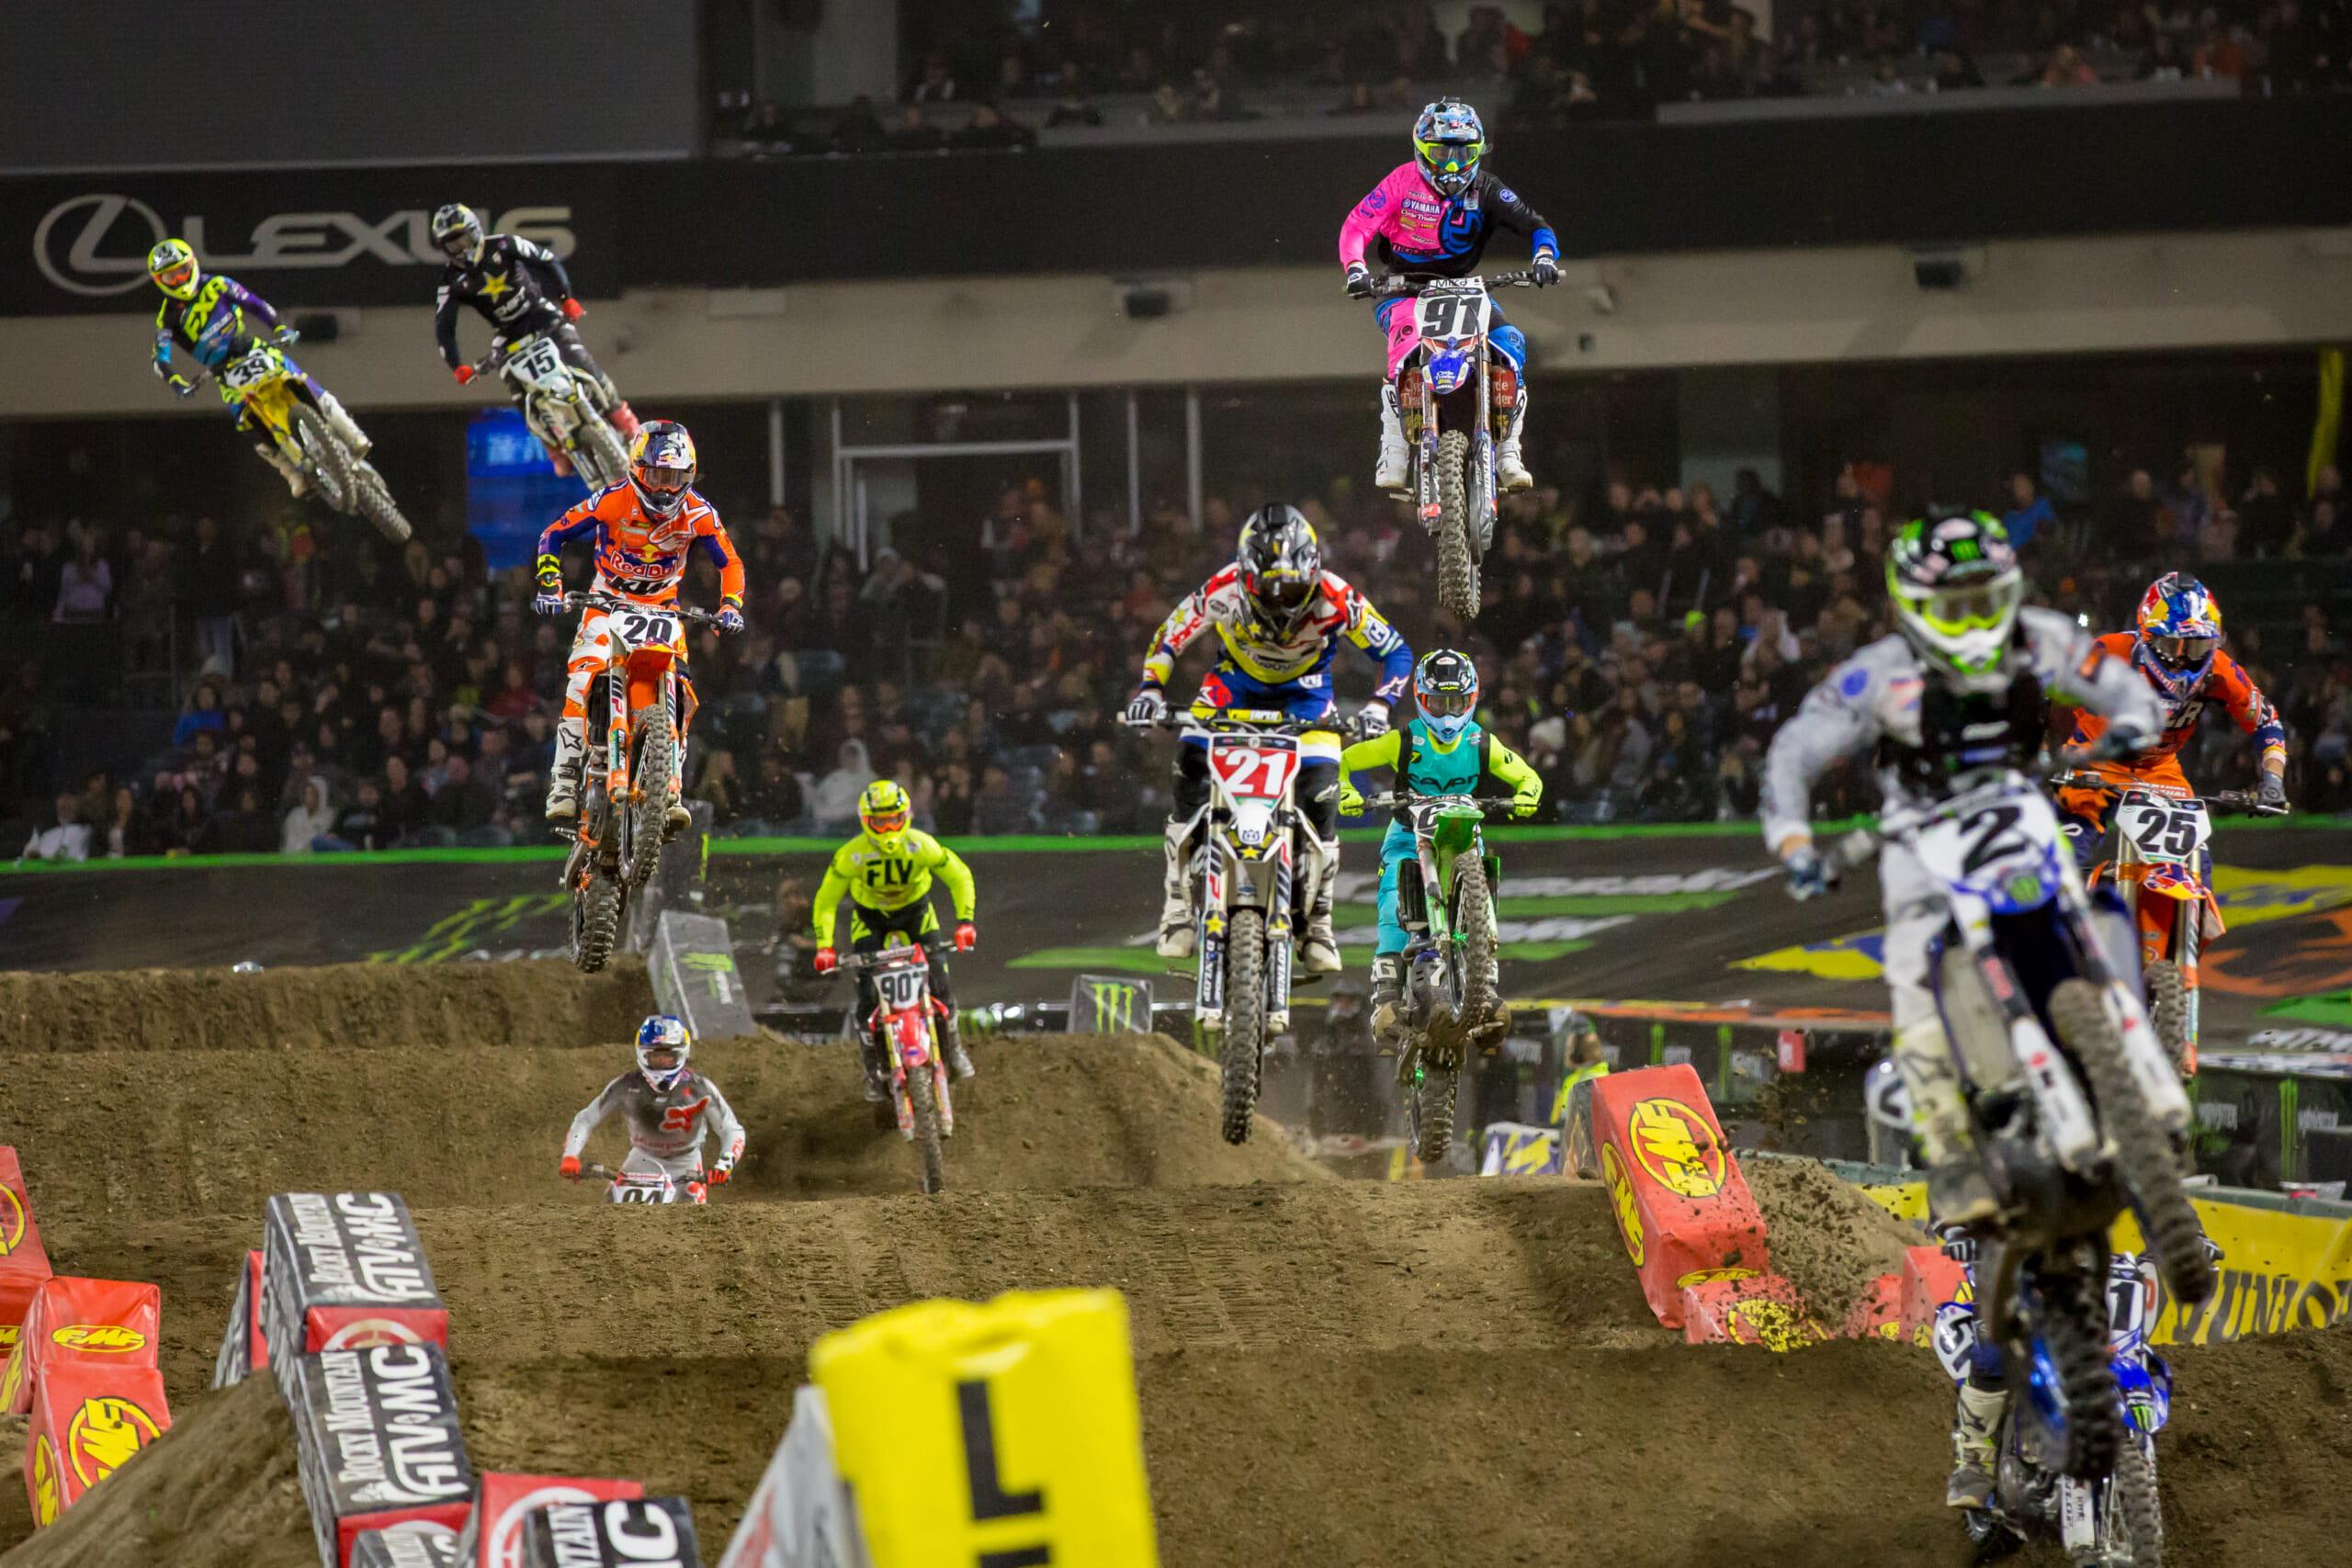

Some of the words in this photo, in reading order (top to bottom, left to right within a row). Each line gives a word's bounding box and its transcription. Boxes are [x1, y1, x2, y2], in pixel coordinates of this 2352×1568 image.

[1410, 200, 1441, 215] YAMAHA
[186, 206, 576, 267] LEXUS
[184, 276, 228, 343] FXR
[1421, 297, 1482, 337] 91
[521, 349, 557, 380] 15
[610, 551, 648, 576] Red
[623, 615, 673, 644] 20
[1225, 749, 1288, 795] 21
[1959, 805, 2027, 879] 2
[2135, 808, 2197, 856] 25
[866, 858, 913, 887] FLY
[1203, 939, 1215, 1001] DNLOP
[1276, 942, 1285, 1005] DUNLOP
[1635, 1102, 1719, 1195] FMF
[53, 1328, 145, 1349] FMF
[321, 1351, 375, 1433] MOUNTAIN
[337, 1433, 388, 1483] ROCKY
